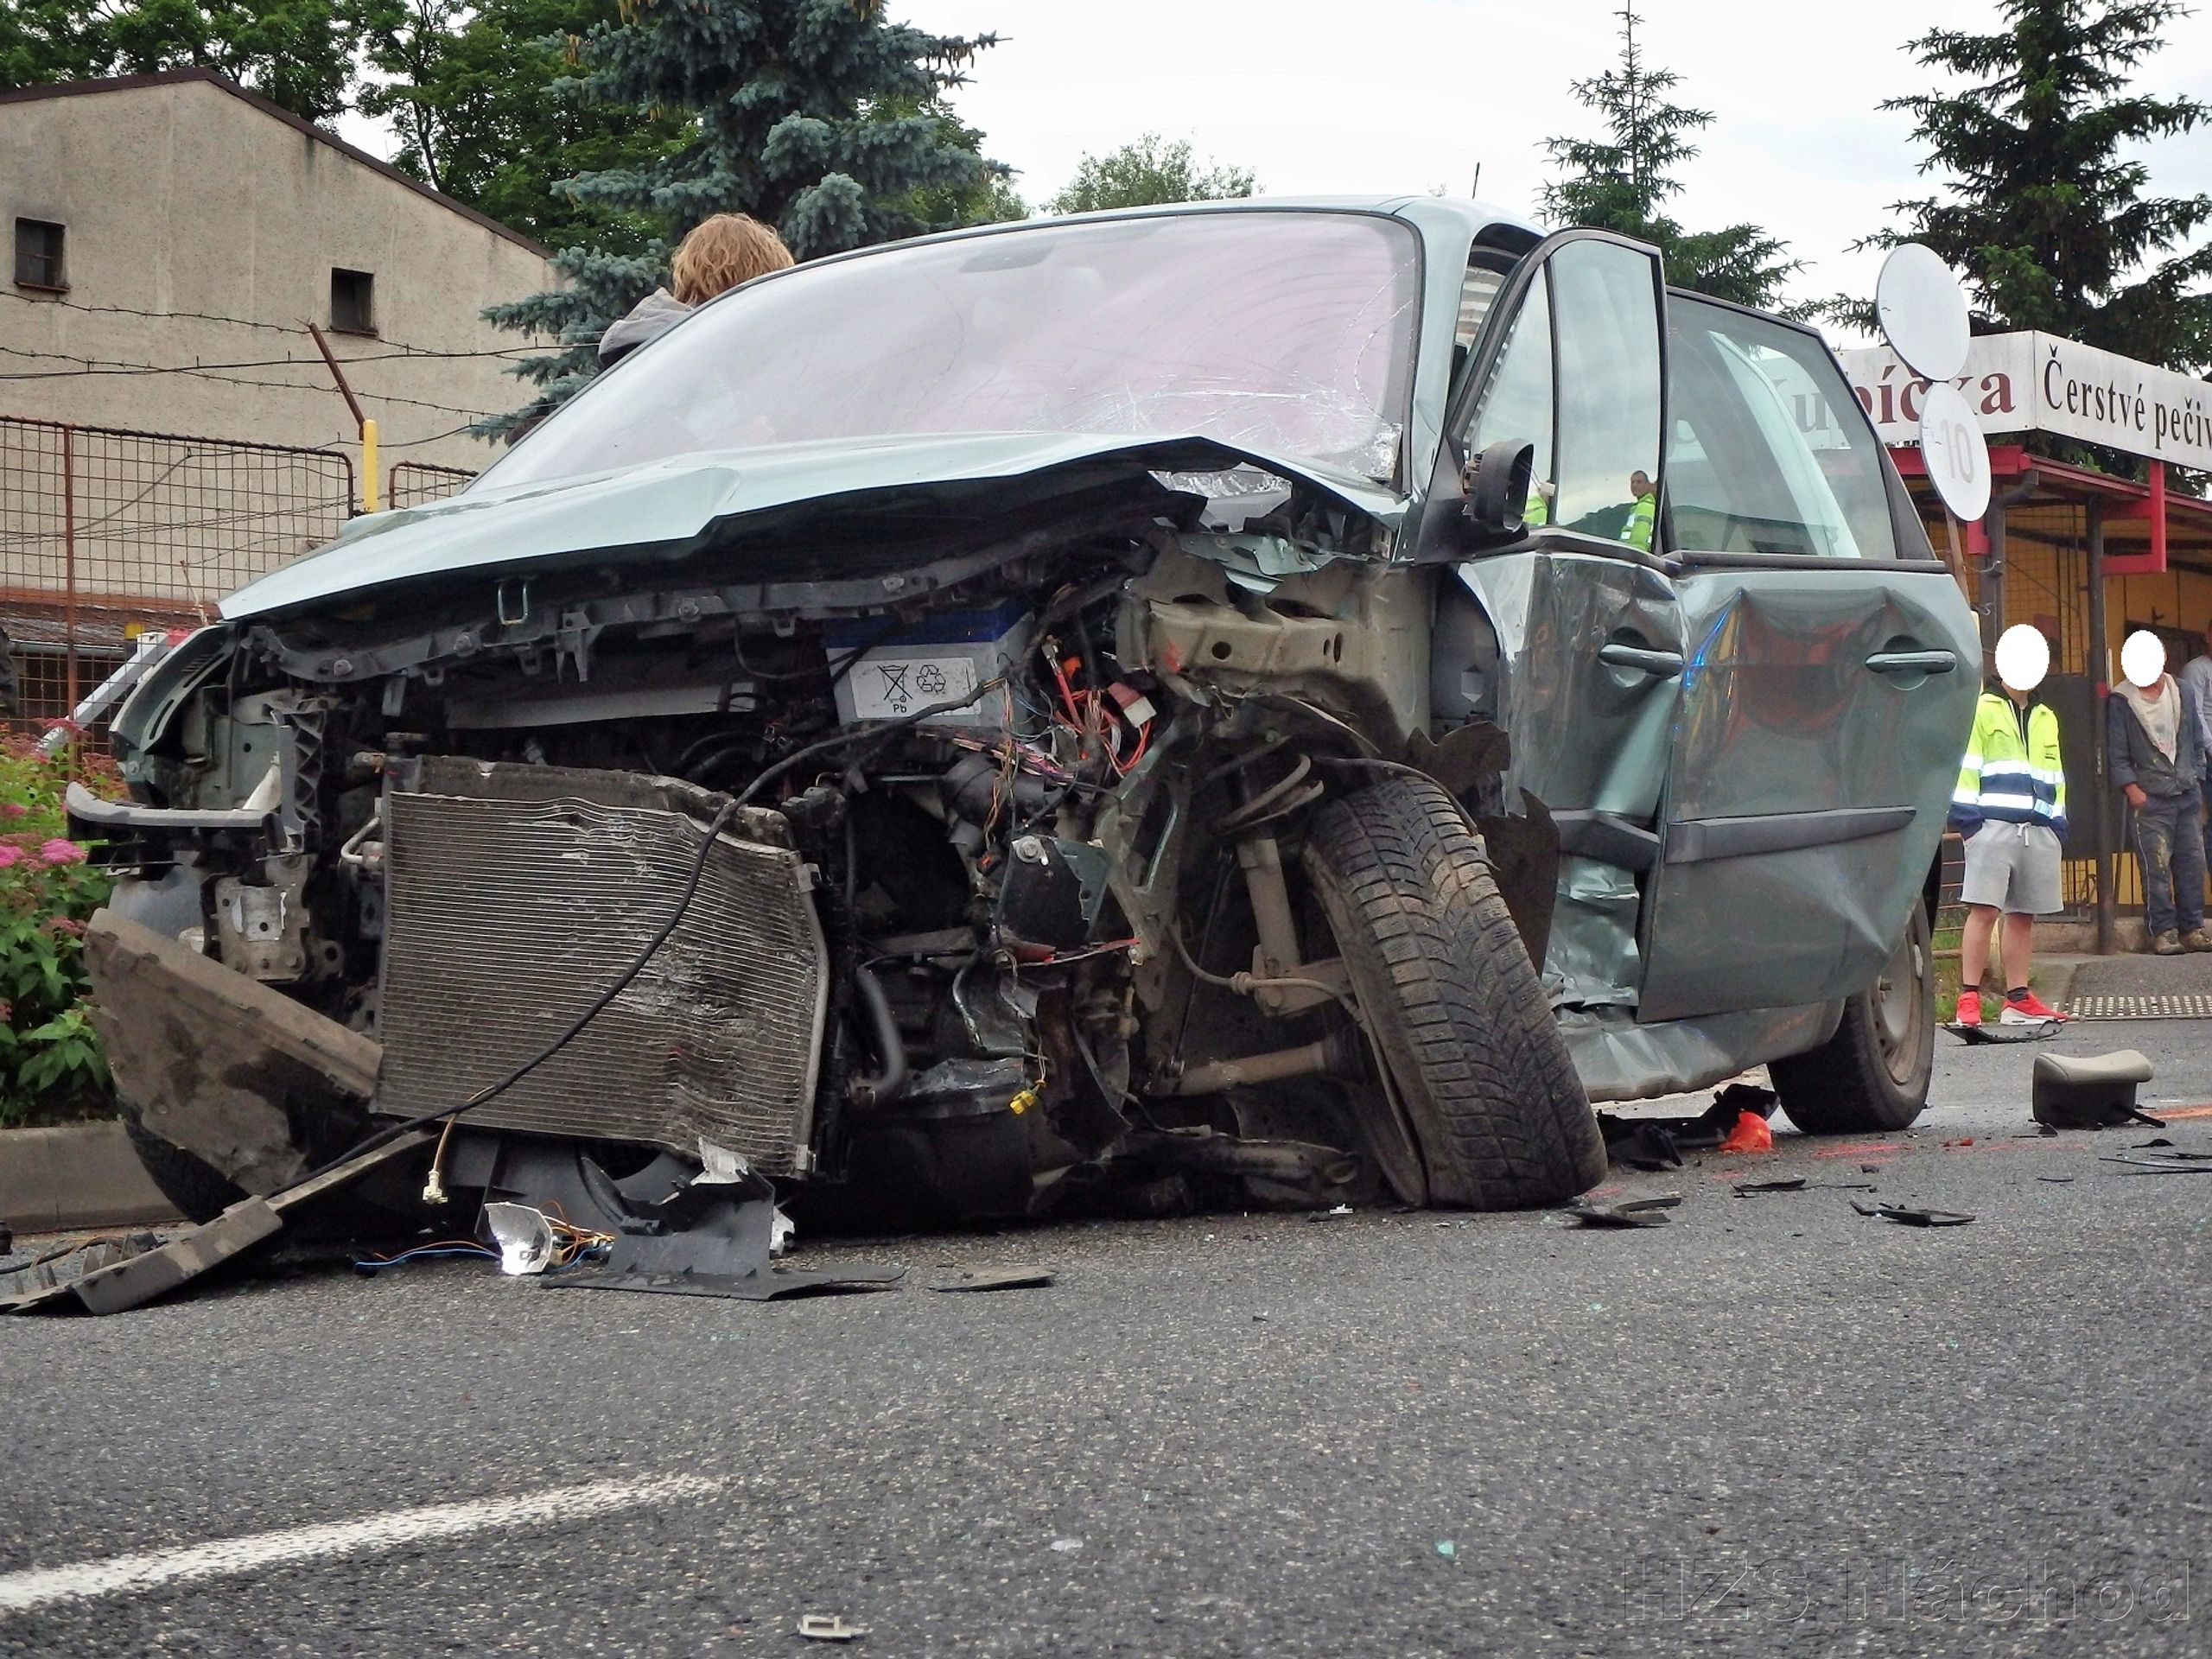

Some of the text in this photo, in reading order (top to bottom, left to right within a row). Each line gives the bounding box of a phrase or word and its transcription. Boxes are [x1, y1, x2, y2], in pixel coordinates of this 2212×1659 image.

[2044, 342, 2146, 432] Čerstvé
[1941, 418, 1975, 484] 10
[893, 702, 908, 714] Pb
